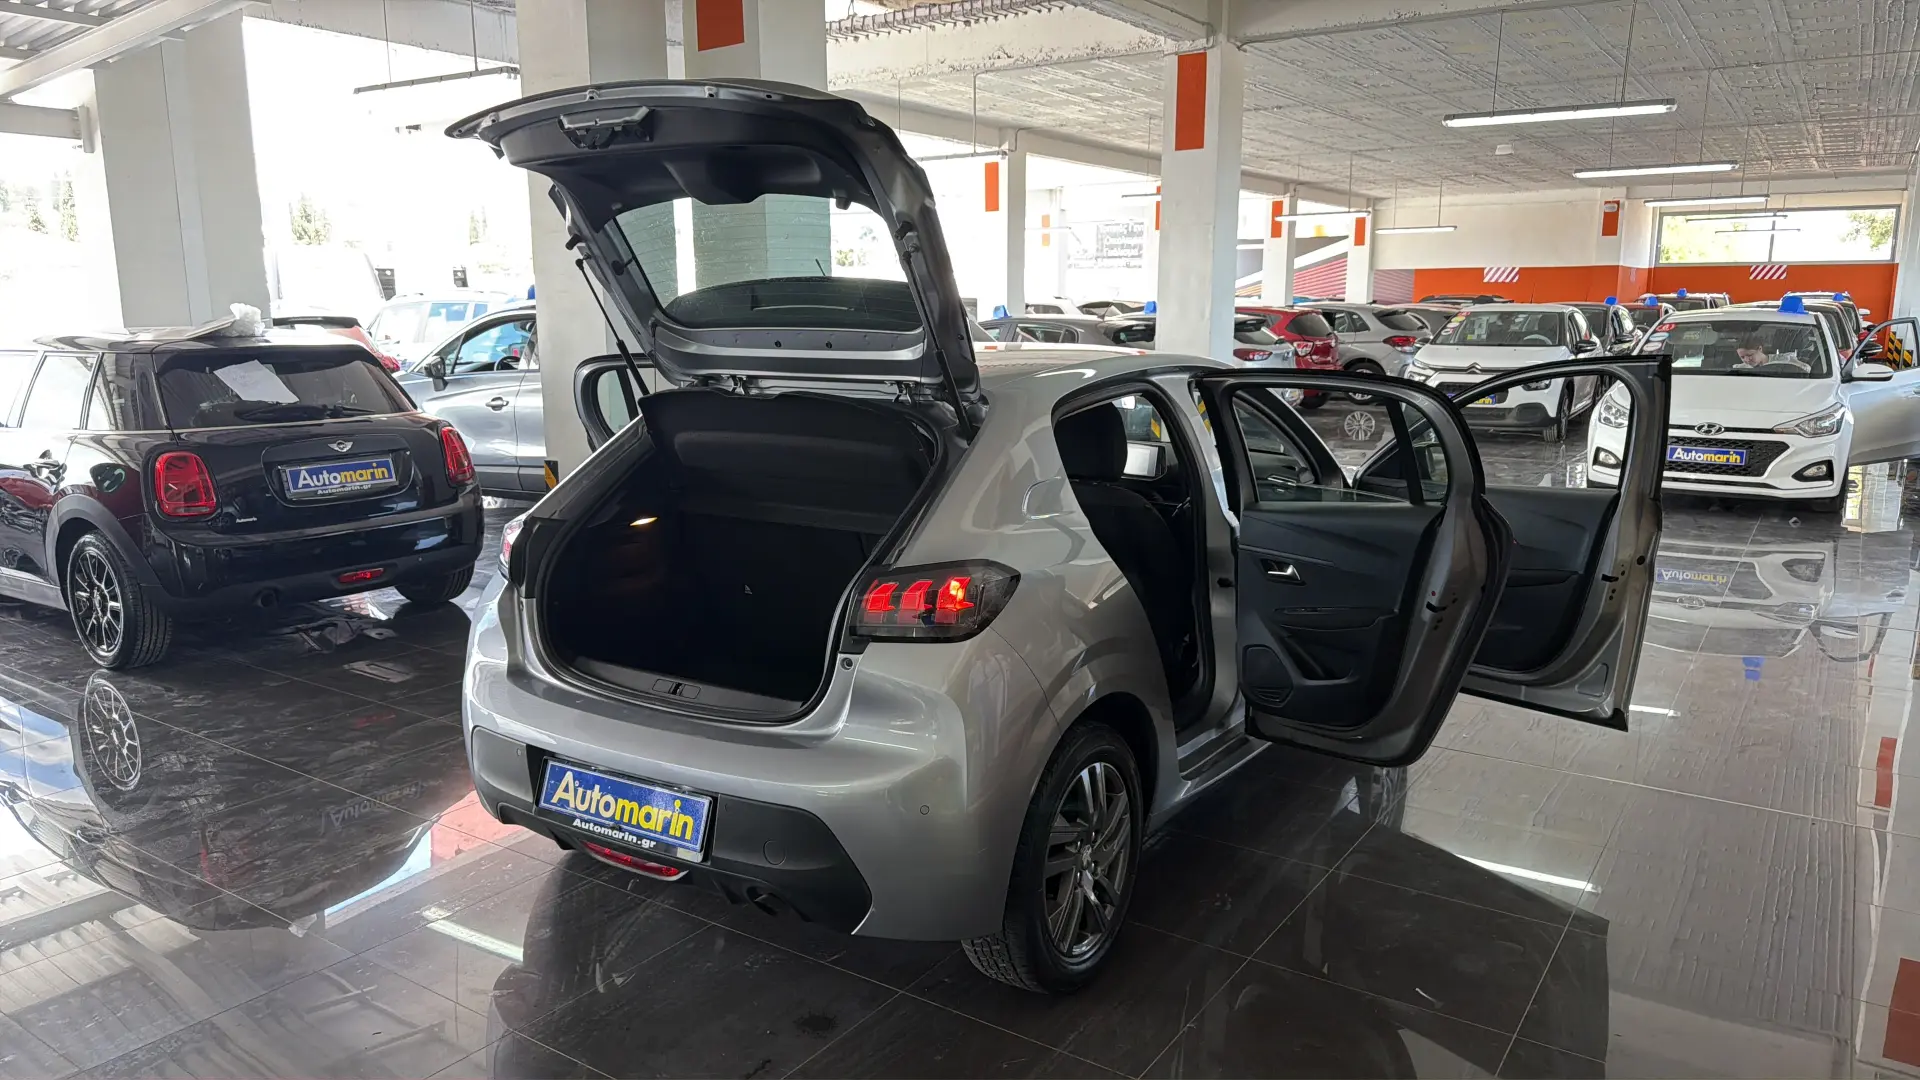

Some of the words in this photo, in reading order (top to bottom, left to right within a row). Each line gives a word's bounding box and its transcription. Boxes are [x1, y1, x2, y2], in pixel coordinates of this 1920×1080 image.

[1672, 447, 1741, 463] Automarin
[298, 463, 389, 488] Automarin
[551, 770, 694, 840] Automarin
[573, 818, 657, 849] Automarin.gr
